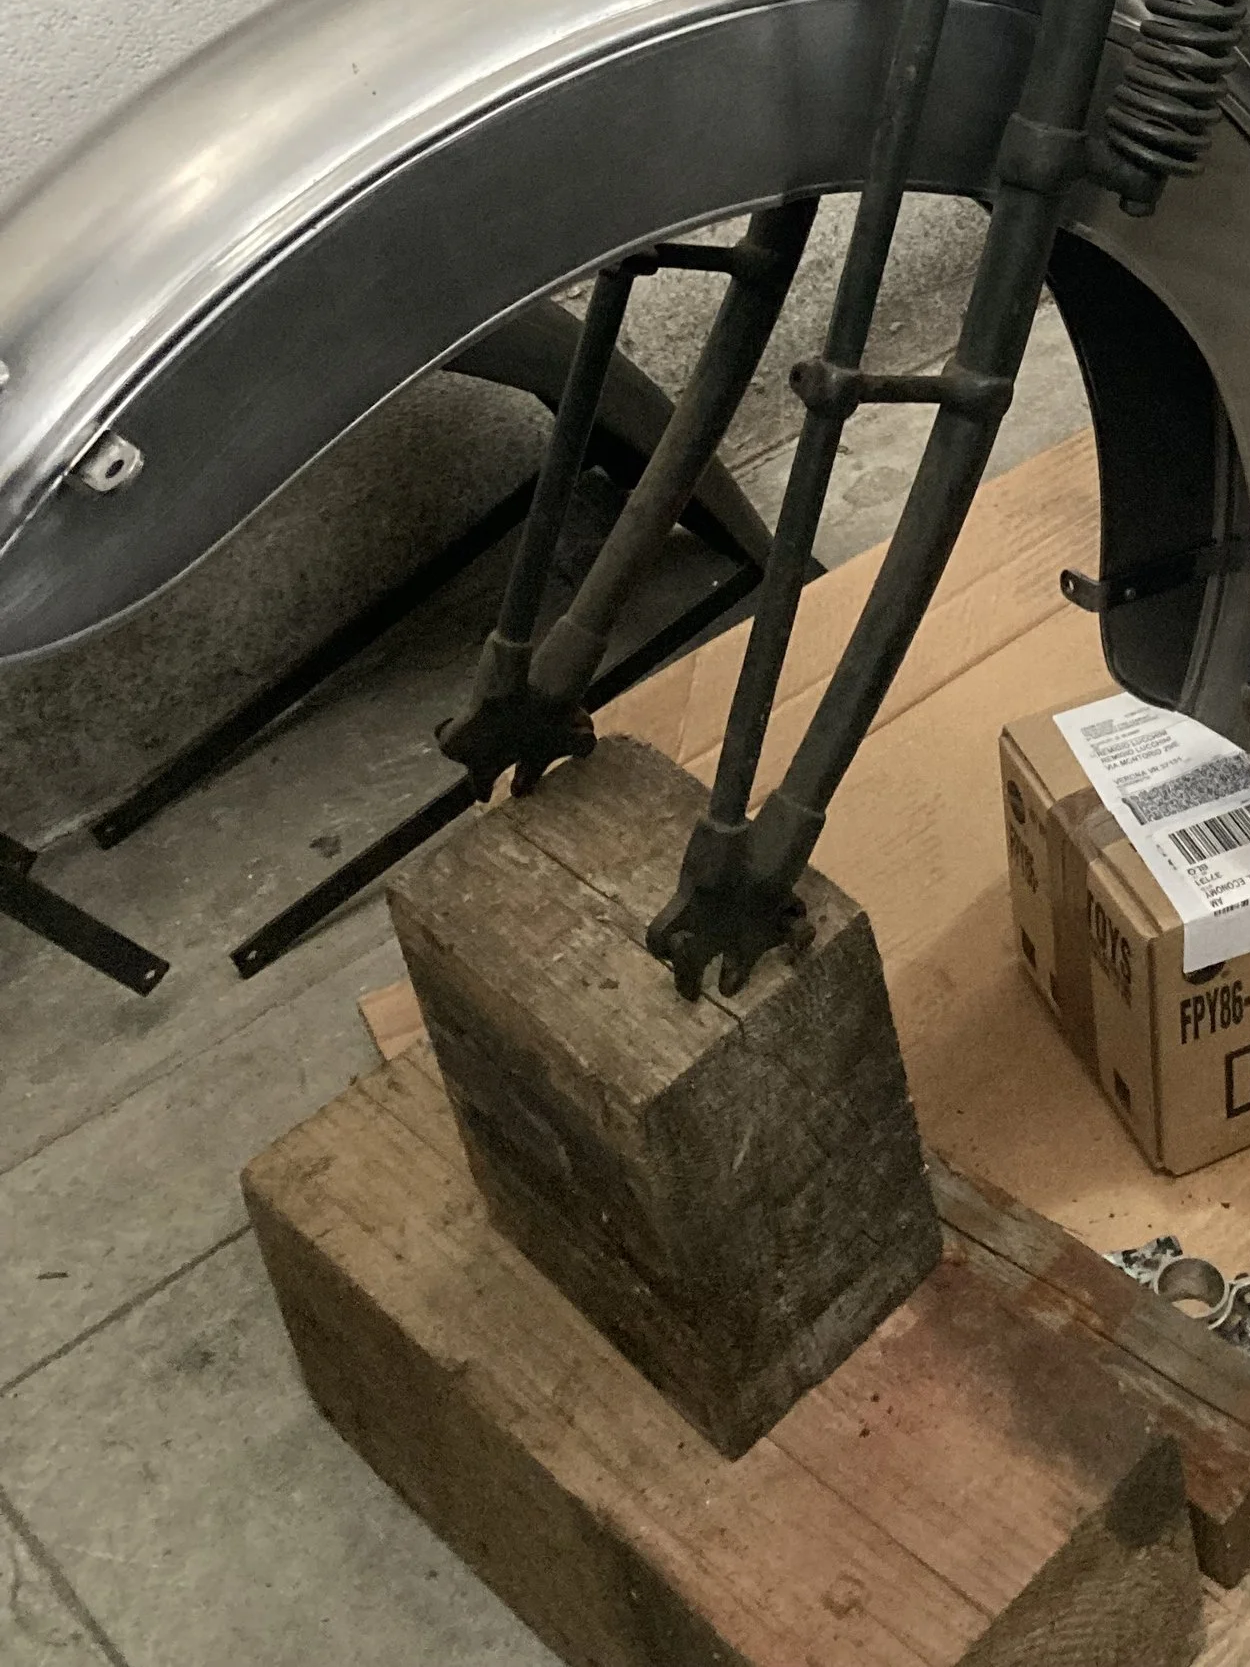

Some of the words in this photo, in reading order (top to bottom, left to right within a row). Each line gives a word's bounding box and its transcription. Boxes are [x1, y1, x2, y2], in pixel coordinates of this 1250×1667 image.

[1114, 771, 1147, 784] VERONA
[1206, 877, 1246, 899] ECONOMY
[1209, 897, 1223, 908] AM
